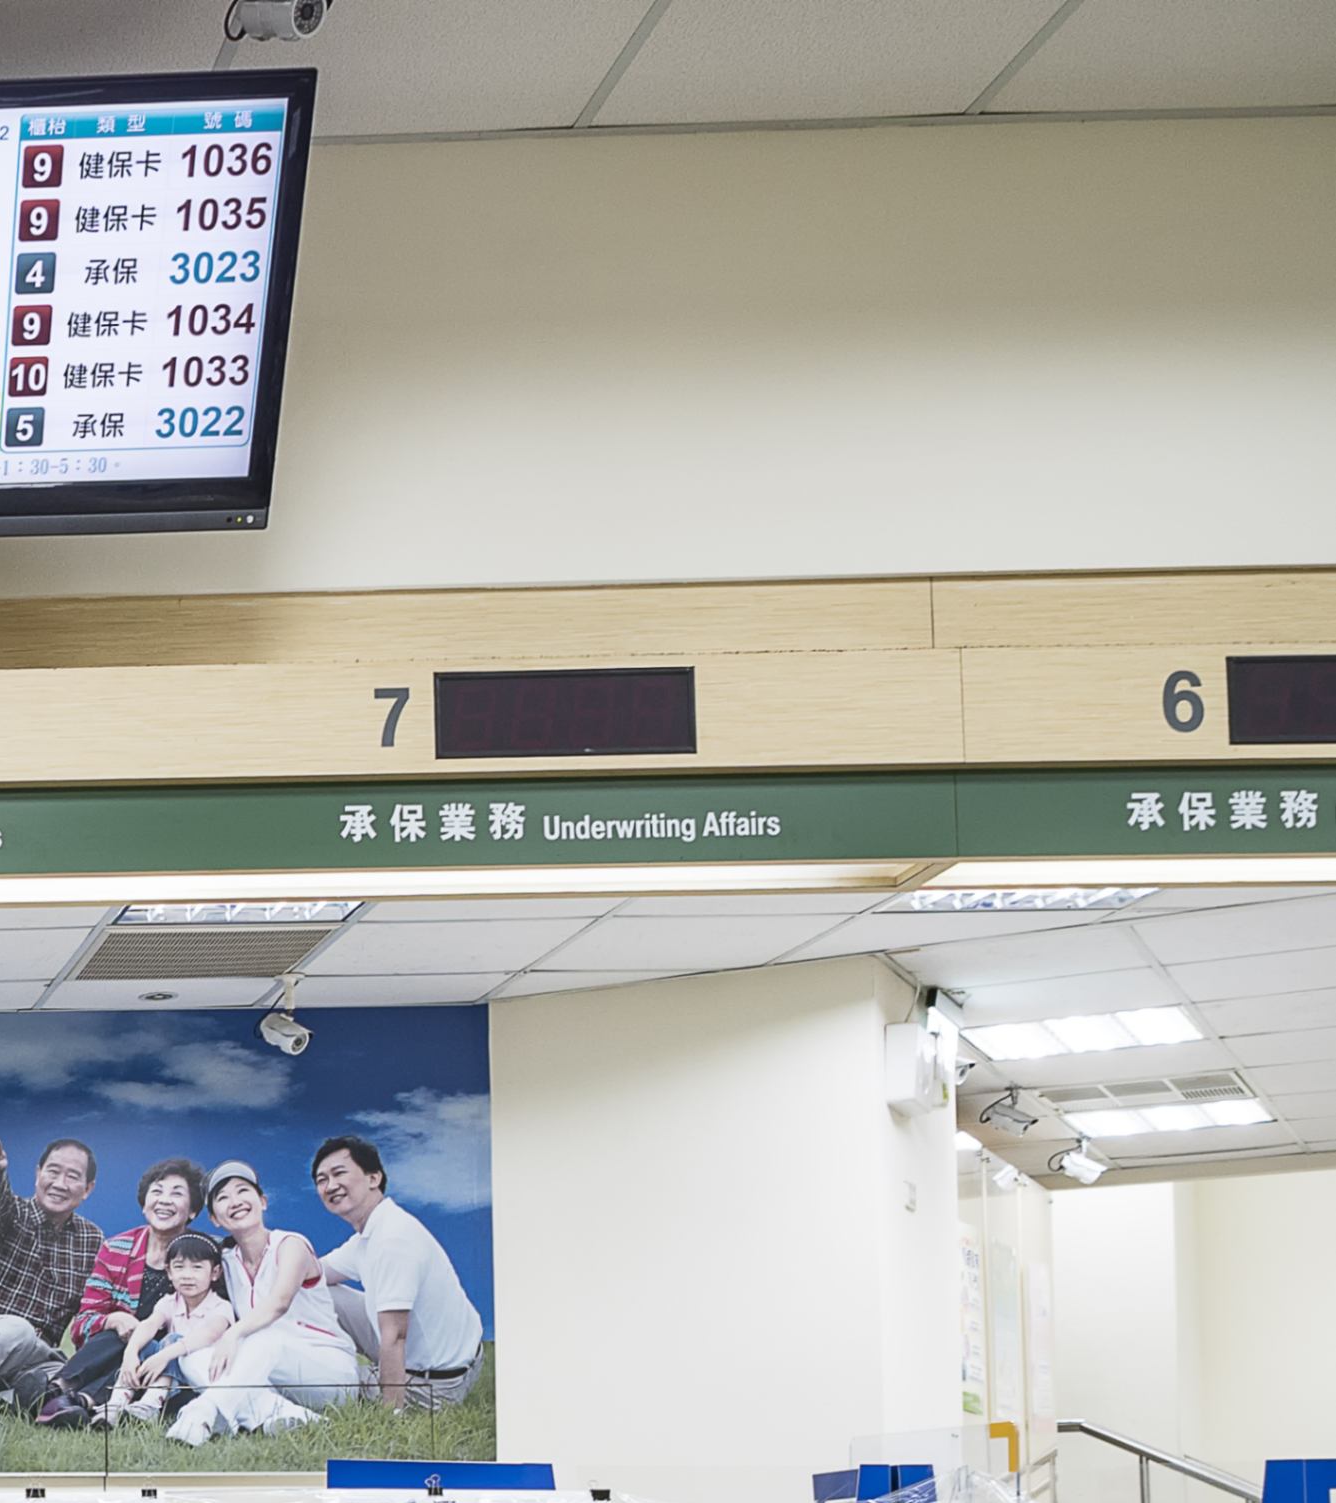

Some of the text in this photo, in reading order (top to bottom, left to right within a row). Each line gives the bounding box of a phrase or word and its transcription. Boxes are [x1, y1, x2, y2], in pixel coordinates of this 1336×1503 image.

[96, 114, 146, 135] 類型
[204, 110, 253, 130] 號碼
[33, 142, 272, 183] 9 健保卡 1036
[29, 197, 268, 236] 9 健保卡 1035
[25, 250, 261, 288] 4 承保 3023
[22, 303, 256, 340] 9 健保卡 1034
[11, 354, 250, 392] 10 健保卡 1033
[15, 405, 246, 442] 5 承保 3022
[373, 687, 411, 748] 7
[1162, 670, 1205, 733] 6
[339, 803, 781, 845] 承保業務 Underwriting Affairs
[1127, 789, 1319, 832] 承保業務
